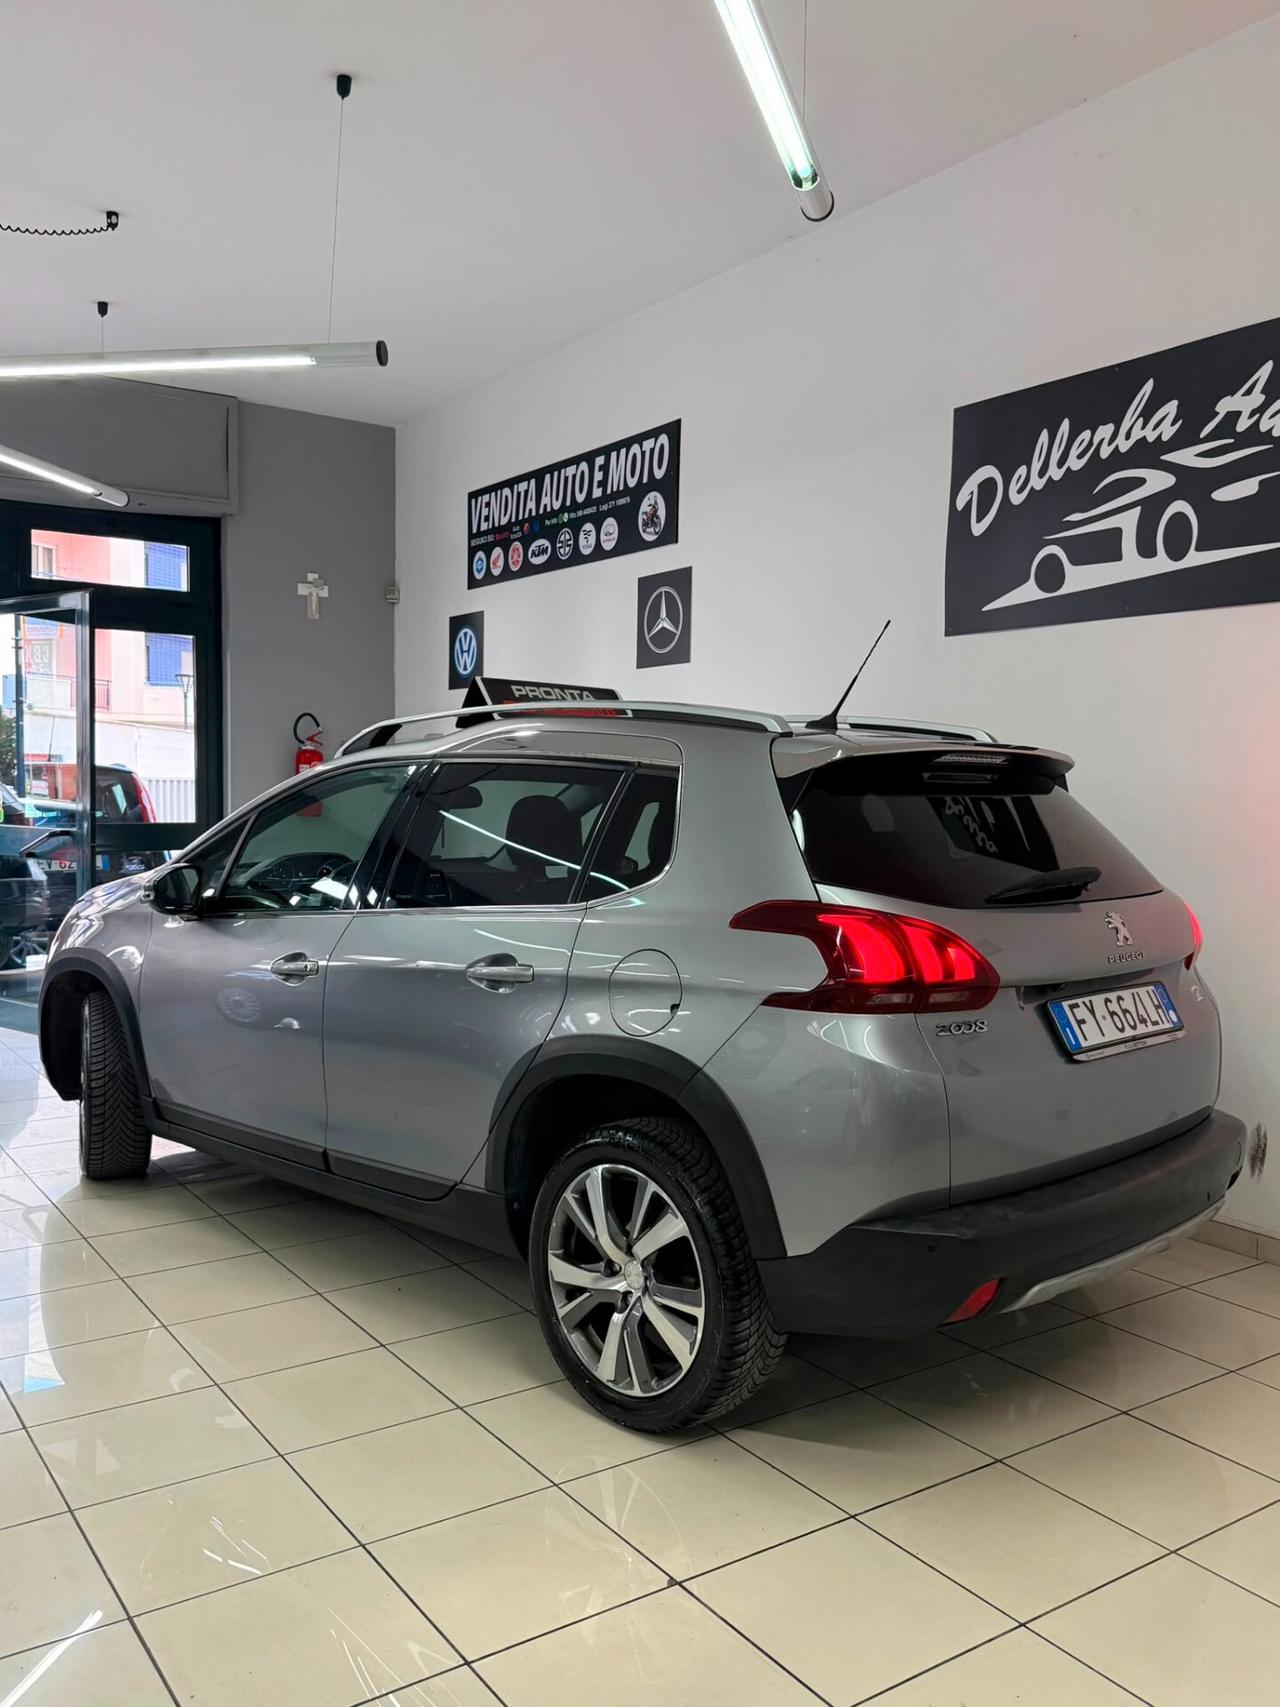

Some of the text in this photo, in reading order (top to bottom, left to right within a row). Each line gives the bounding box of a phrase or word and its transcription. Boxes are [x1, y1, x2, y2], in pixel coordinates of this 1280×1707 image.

[955, 378, 1183, 537] Dellerba
[472, 433, 670, 534] VENDITA AUTO E MOTO
[530, 543, 549, 559] KTM
[511, 684, 596, 701] PRONTA
[1108, 951, 1147, 965] PEUGEOT
[935, 1019, 988, 1037] 2008
